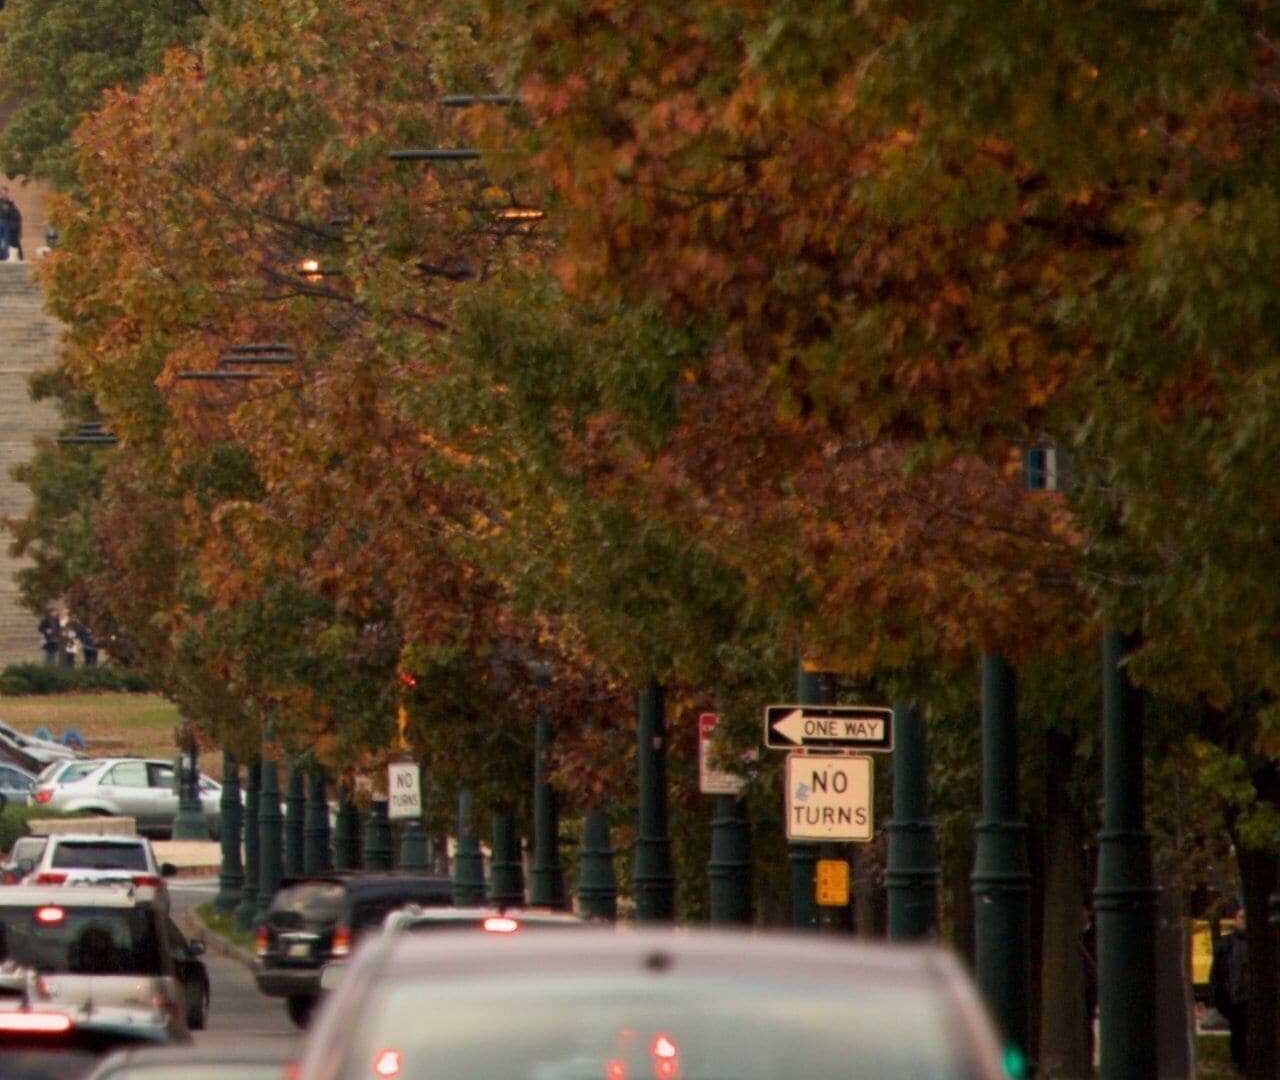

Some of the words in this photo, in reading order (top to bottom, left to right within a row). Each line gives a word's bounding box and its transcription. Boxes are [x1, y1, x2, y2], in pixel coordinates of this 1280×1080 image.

[804, 720, 838, 736] ONE
[845, 721, 879, 737] WAY
[396, 772, 414, 789] NO
[812, 769, 848, 794] NO
[794, 806, 867, 825] TURNS
